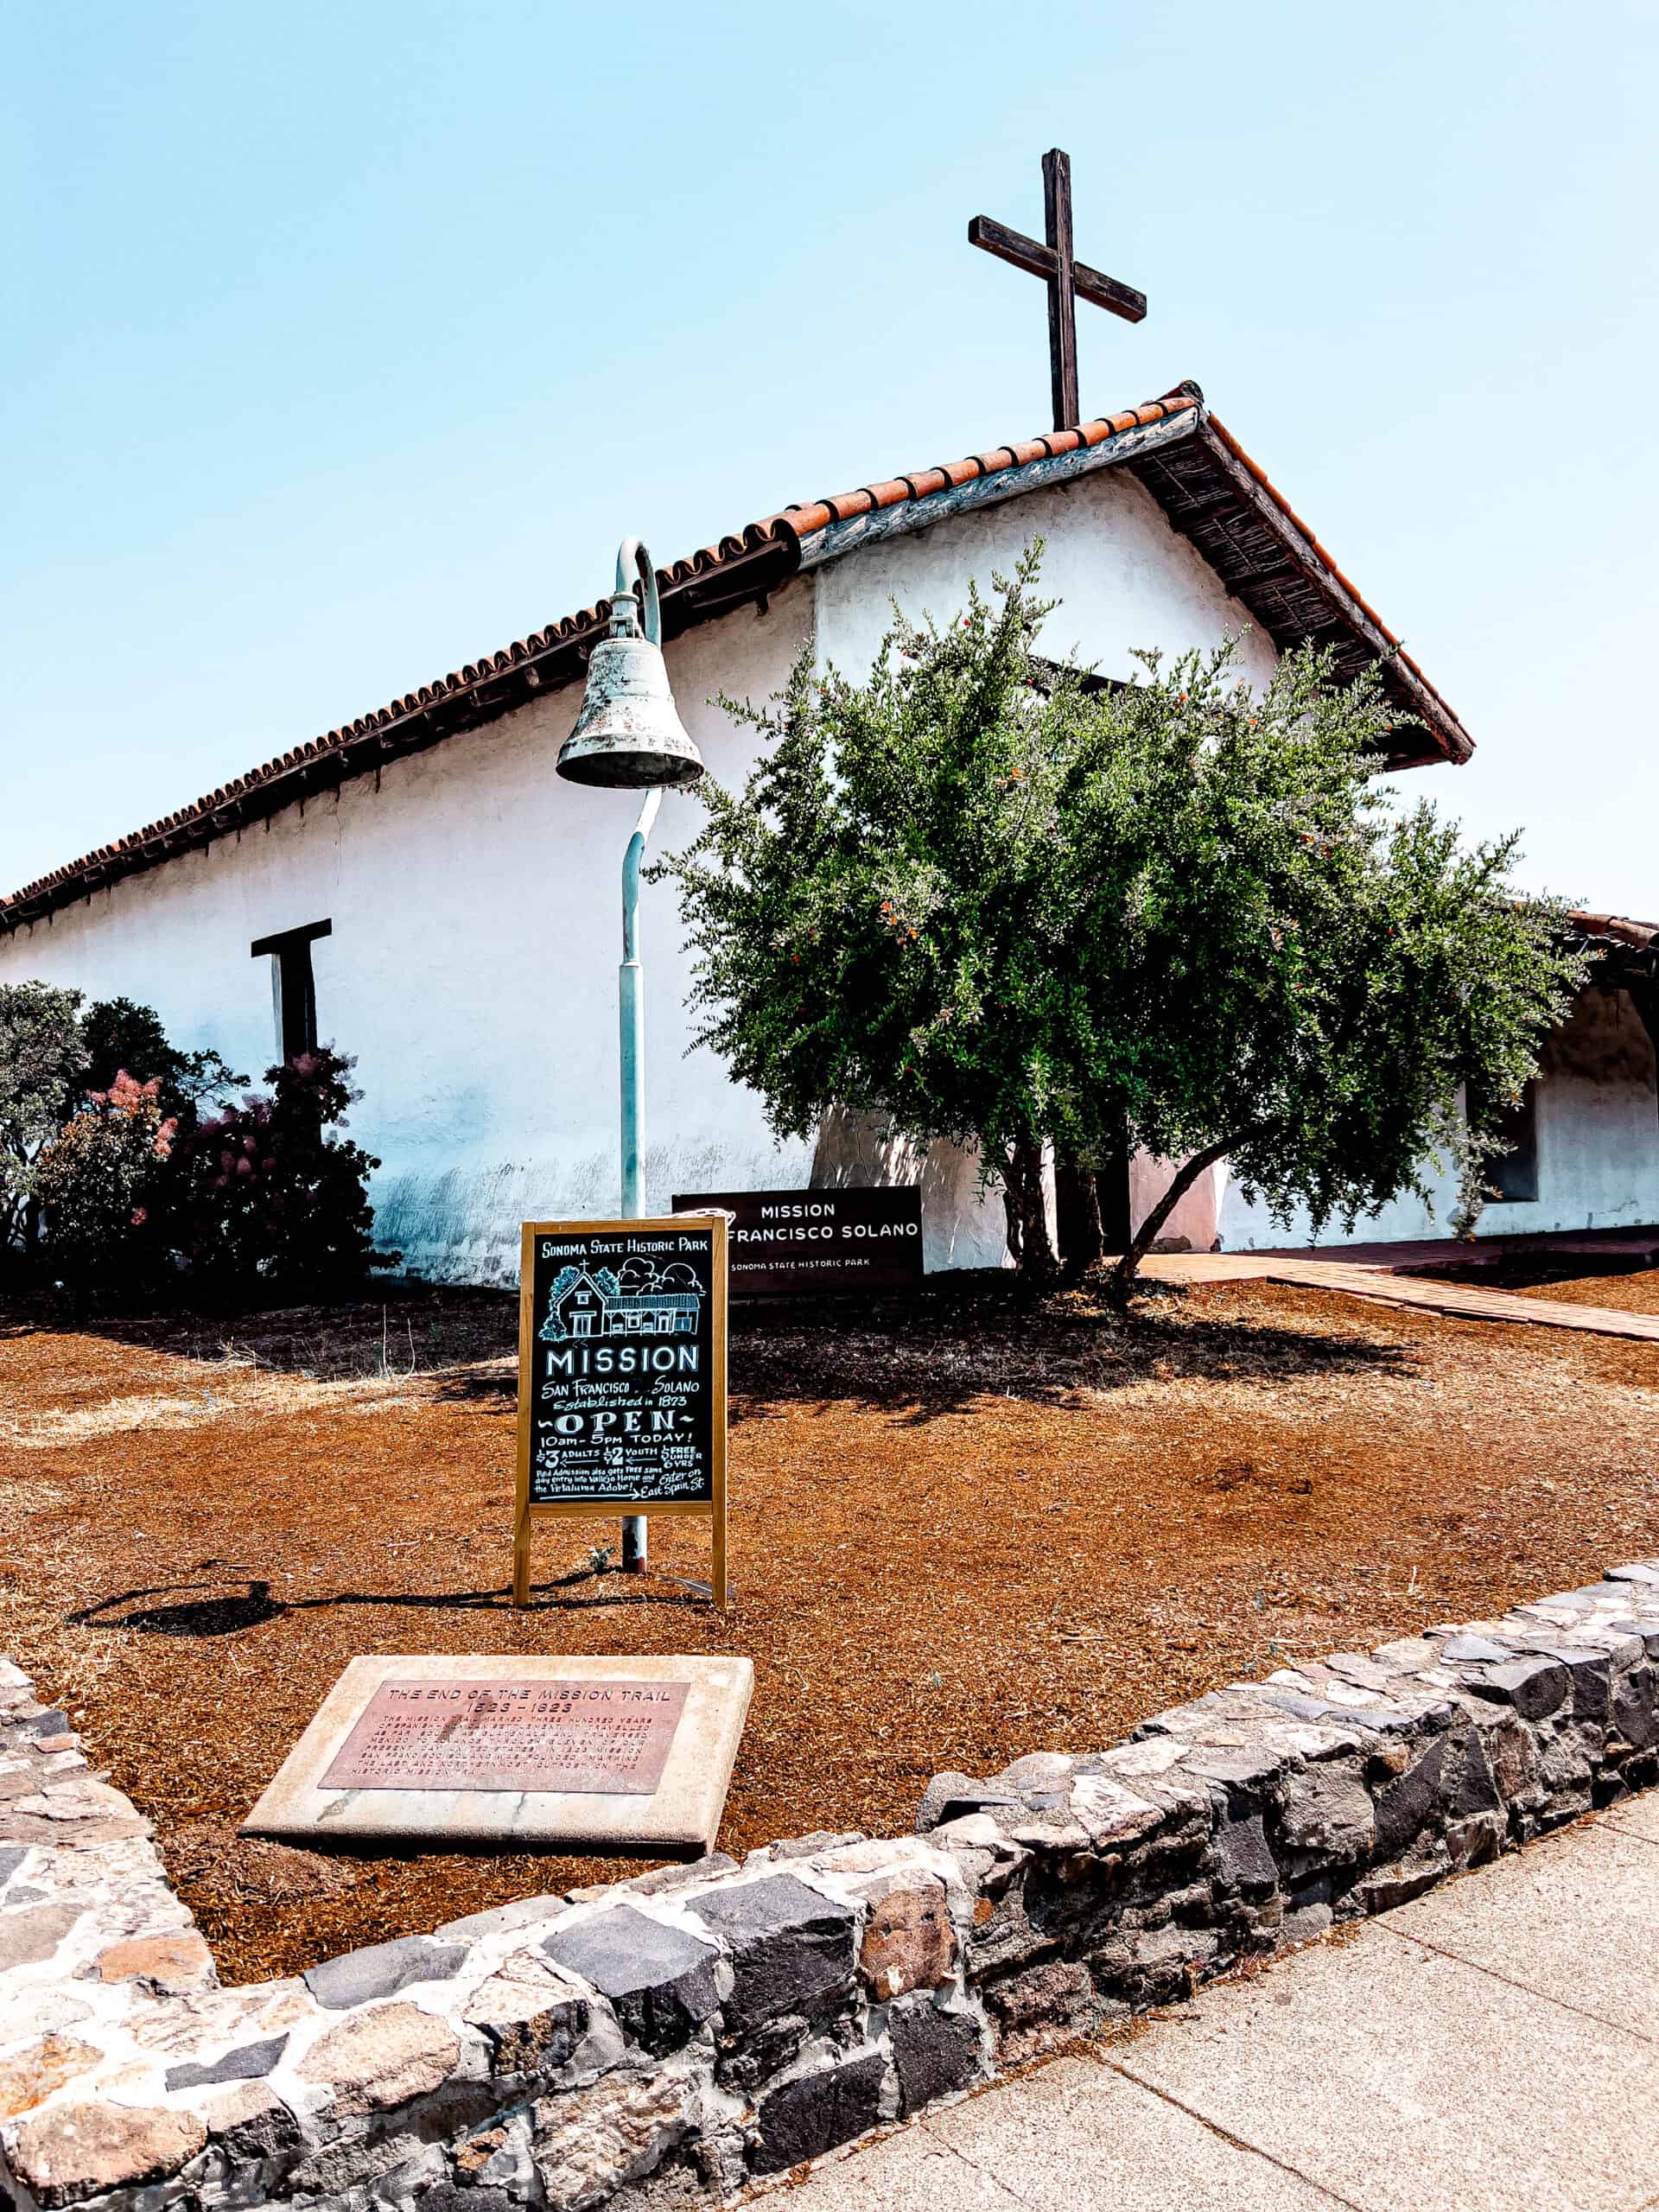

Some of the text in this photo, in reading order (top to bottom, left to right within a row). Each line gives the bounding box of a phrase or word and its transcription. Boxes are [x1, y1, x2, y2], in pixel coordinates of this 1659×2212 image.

[761, 1204, 836, 1218] MISSION
[727, 1223, 918, 1243] FRANCISCO SOLANO
[590, 1239, 624, 1255] STATE
[627, 1238, 675, 1253] HISTORIC
[678, 1236, 708, 1252] PARK
[731, 1258, 871, 1272] SONOMA STATE HISTORIC PARK
[546, 1345, 699, 1376] MISSION
[541, 1375, 700, 1399] SAN FRANCISCO SOLANO
[553, 1395, 643, 1411] Established
[658, 1395, 688, 1408] 1823
[562, 1449, 601, 1459] ADULTS
[664, 1460, 673, 1469] 6
[551, 1476, 573, 1484] entry
[588, 1474, 616, 1484] Vallejo
[617, 1473, 640, 1482] Home
[553, 1468, 590, 1477] Admission
[591, 1467, 607, 1476] also
[607, 1467, 624, 1476] gets
[658, 1468, 702, 1485] Enter on
[534, 1484, 548, 1493] the
[640, 1486, 664, 1498] East
[664, 1482, 690, 1496] Spain
[390, 1690, 671, 1701] THE END OF THE MISSION TRAIL
